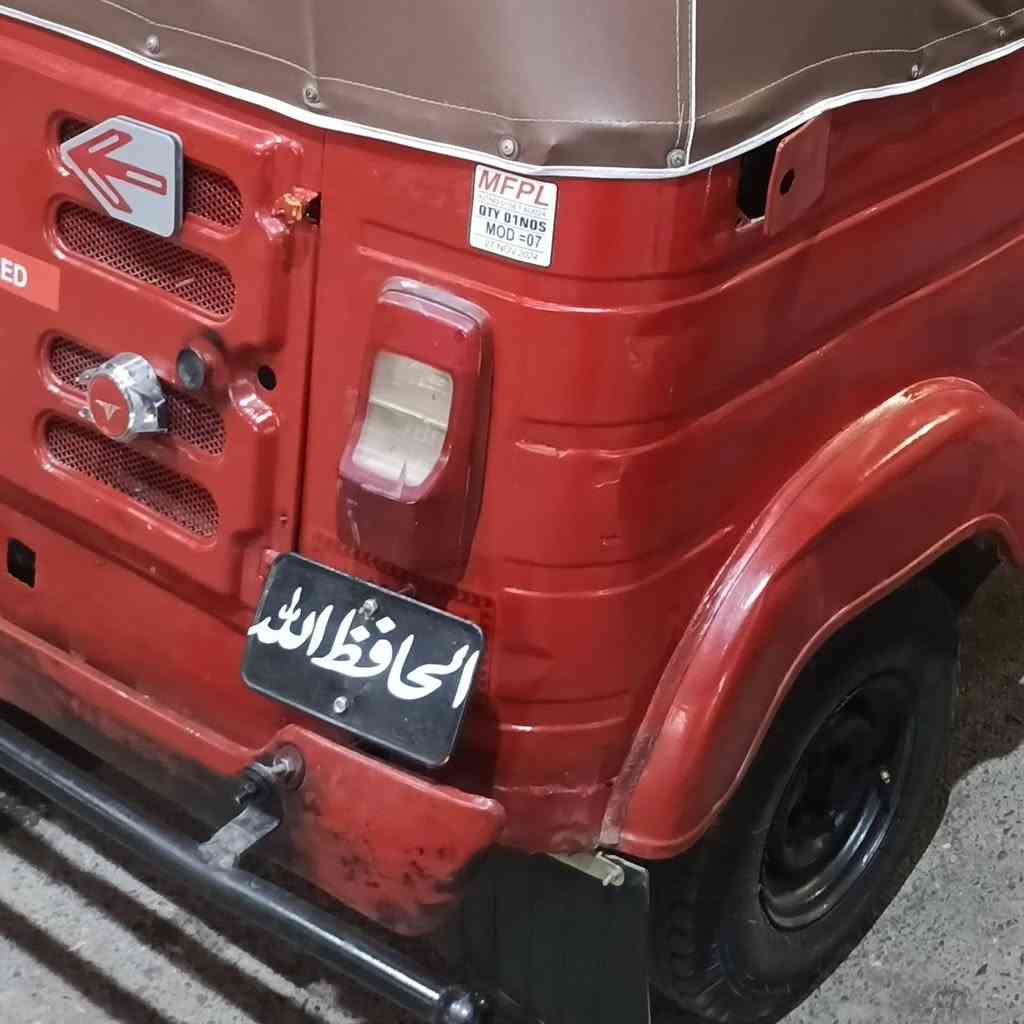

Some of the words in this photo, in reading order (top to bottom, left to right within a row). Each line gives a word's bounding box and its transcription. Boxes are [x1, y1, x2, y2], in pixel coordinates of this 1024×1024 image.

[478, 169, 549, 207] MFPL
[479, 205, 500, 219] QTY
[486, 221, 515, 242] MOD
[247, 586, 334, 656] الله
[310, 608, 480, 709] الحافظ
